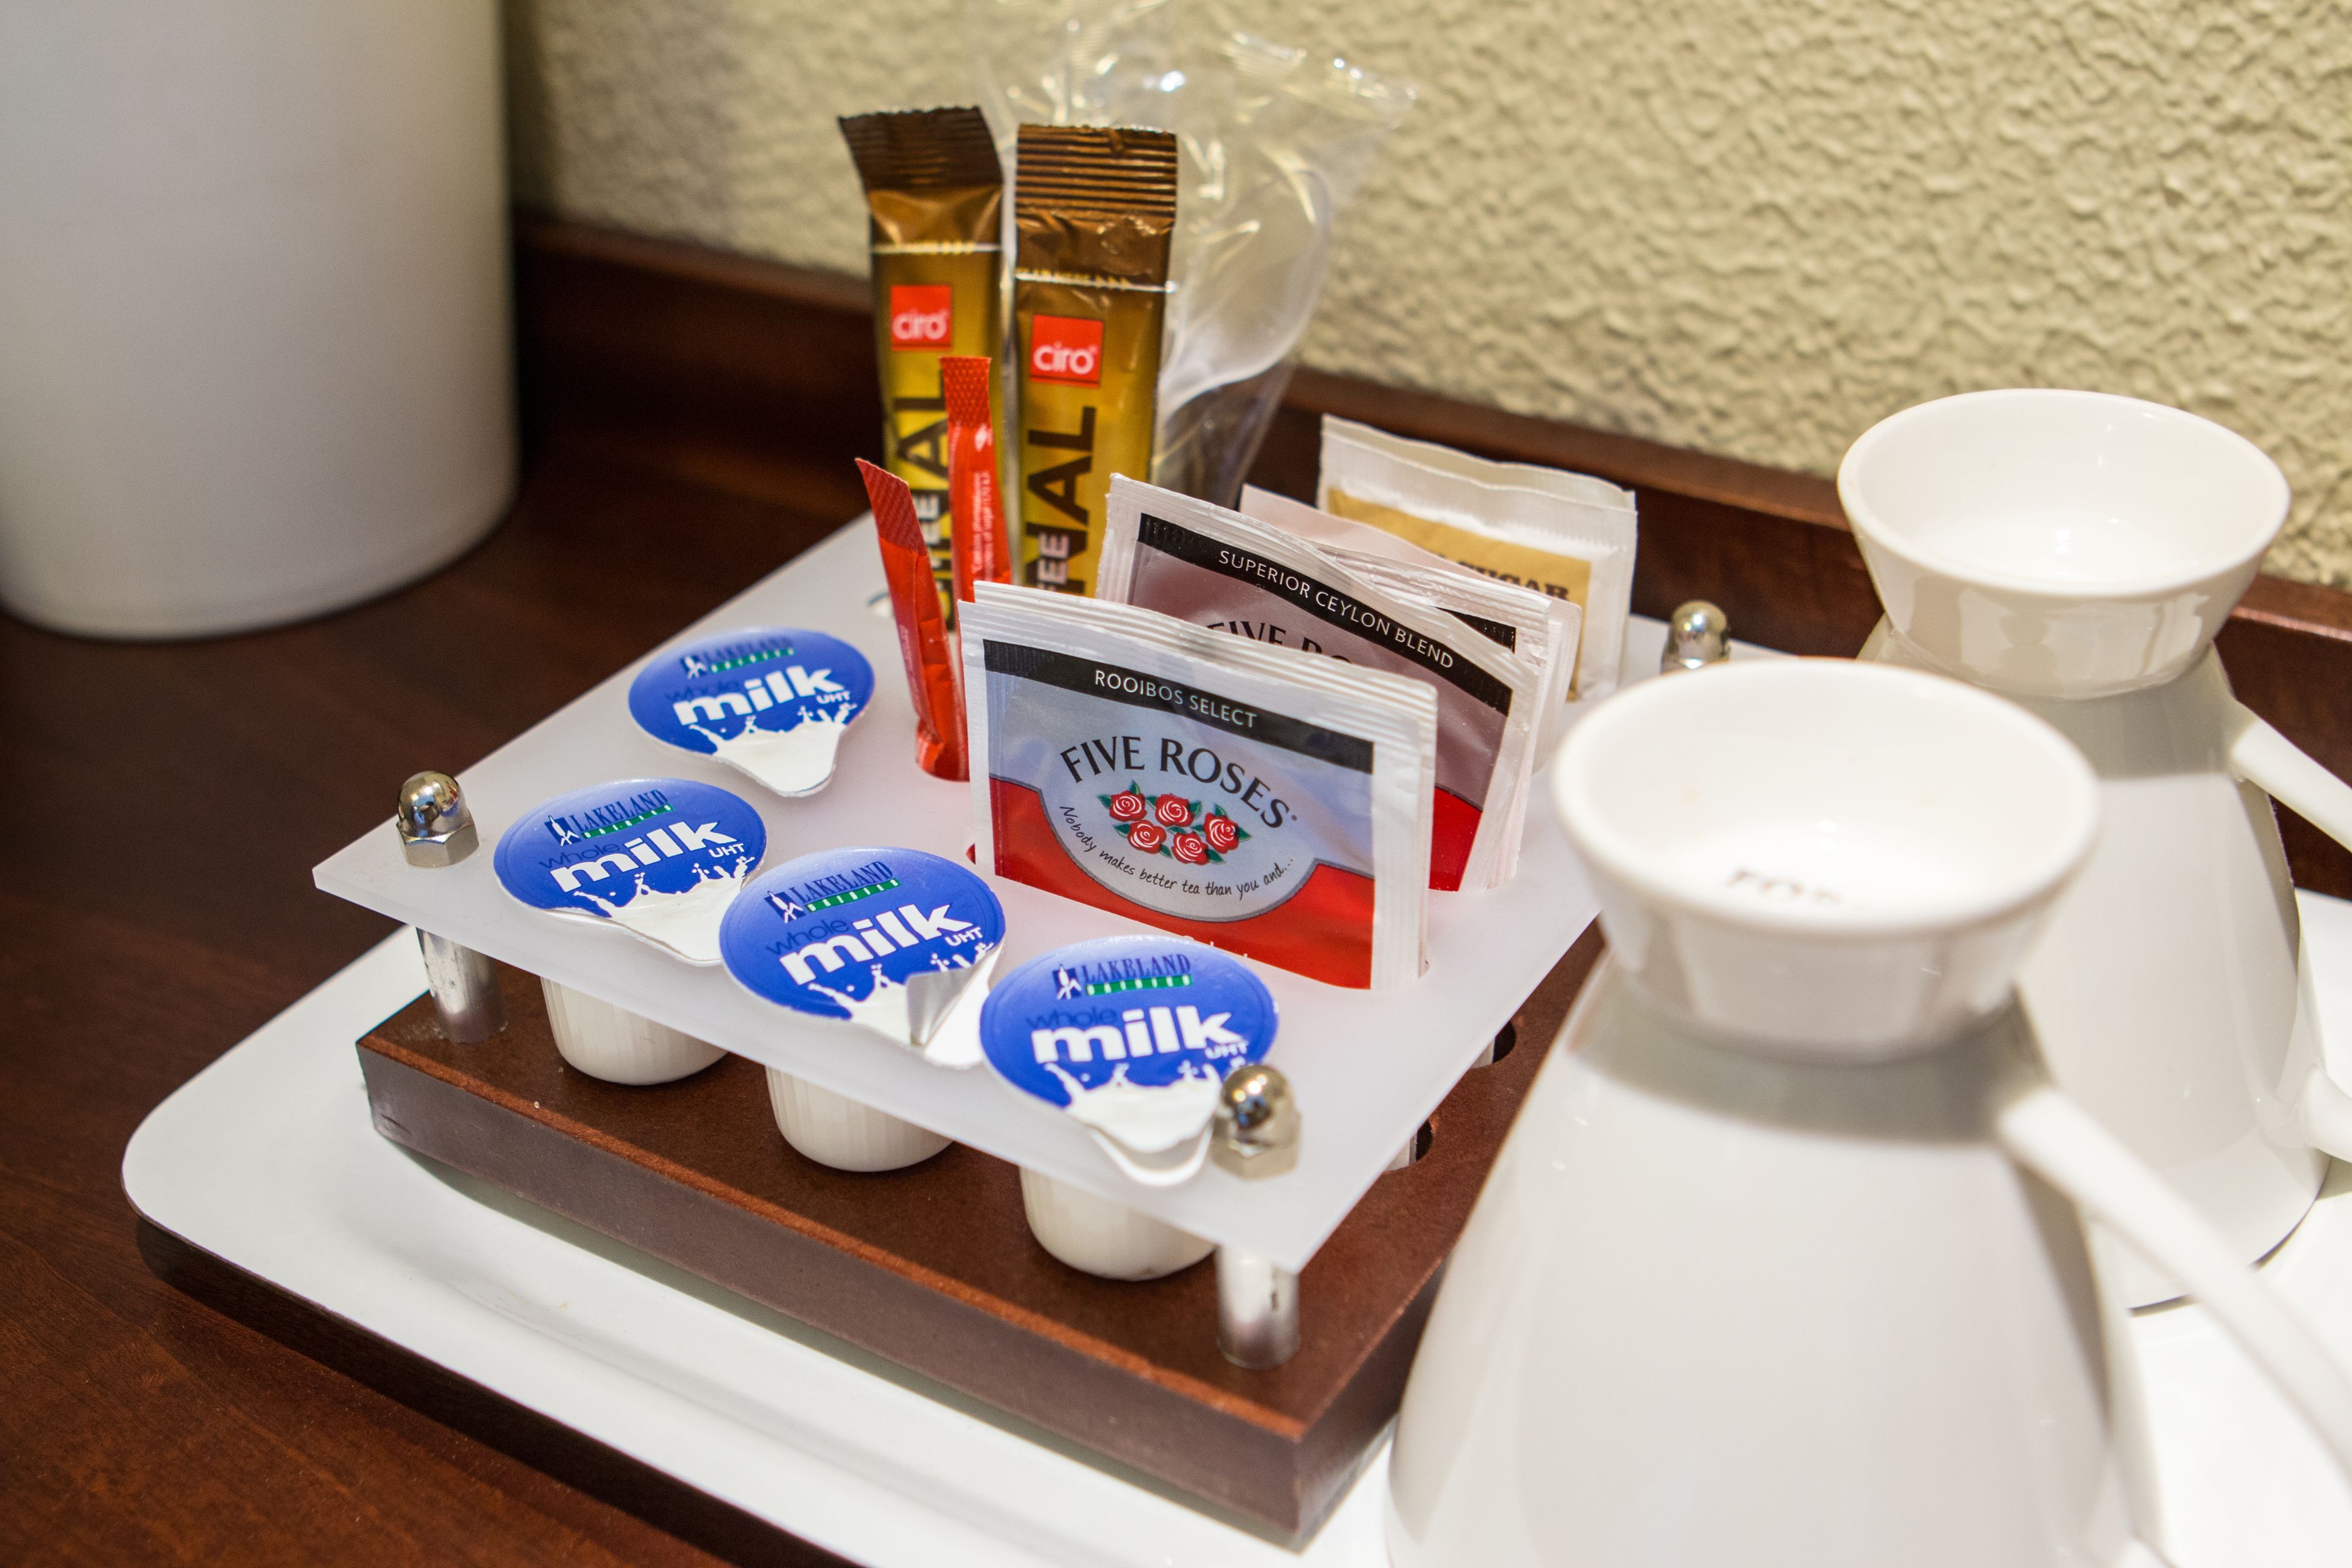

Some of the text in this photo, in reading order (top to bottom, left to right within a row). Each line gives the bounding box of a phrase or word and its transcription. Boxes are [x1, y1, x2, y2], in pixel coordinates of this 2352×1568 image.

[892, 309, 947, 341] ciro
[1033, 344, 1095, 375] ciro
[1218, 549, 1311, 598] SUPERIOR
[1315, 591, 1390, 633] CEYLON
[1395, 627, 1454, 669] BLEND
[673, 665, 845, 726] milk
[816, 691, 851, 704] UHT
[1095, 670, 1257, 728] ROOIBOS SELECT
[1060, 736, 1291, 828] FIVE ROSES
[569, 789, 669, 833] LAKELAND
[538, 842, 621, 869] whole
[550, 821, 737, 892] milk
[708, 843, 745, 858] UHT
[1060, 805, 1295, 901] Nobody makes better tea than you and...
[789, 861, 894, 903] LAKELAND
[765, 919, 850, 956] whole
[779, 903, 974, 986] milk
[944, 927, 984, 947] UHT
[1080, 954, 1192, 982] LAKELAND
[1026, 1006, 1118, 1029] whole
[1031, 1005, 1245, 1064] milk
[1204, 1039, 1250, 1060] UHT
